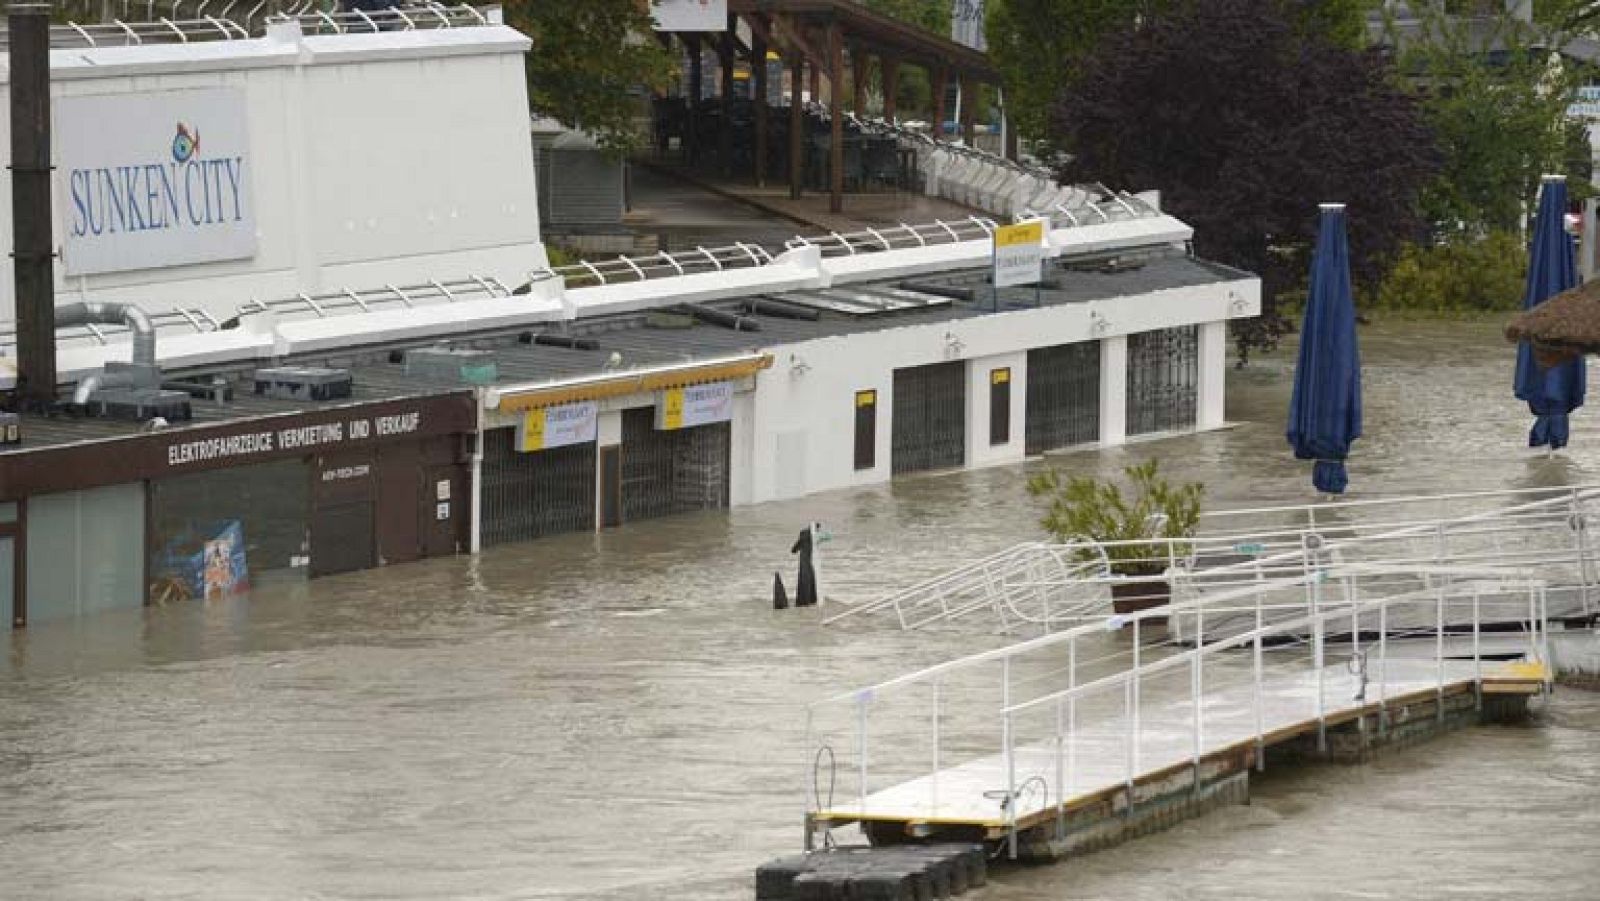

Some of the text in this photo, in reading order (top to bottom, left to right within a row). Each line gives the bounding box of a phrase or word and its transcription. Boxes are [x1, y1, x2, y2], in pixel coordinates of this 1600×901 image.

[71, 156, 242, 236] SUNKEN CITY
[278, 422, 343, 449] VERMIETUNG
[349, 419, 370, 439] UND
[375, 412, 420, 435] VERKAUF
